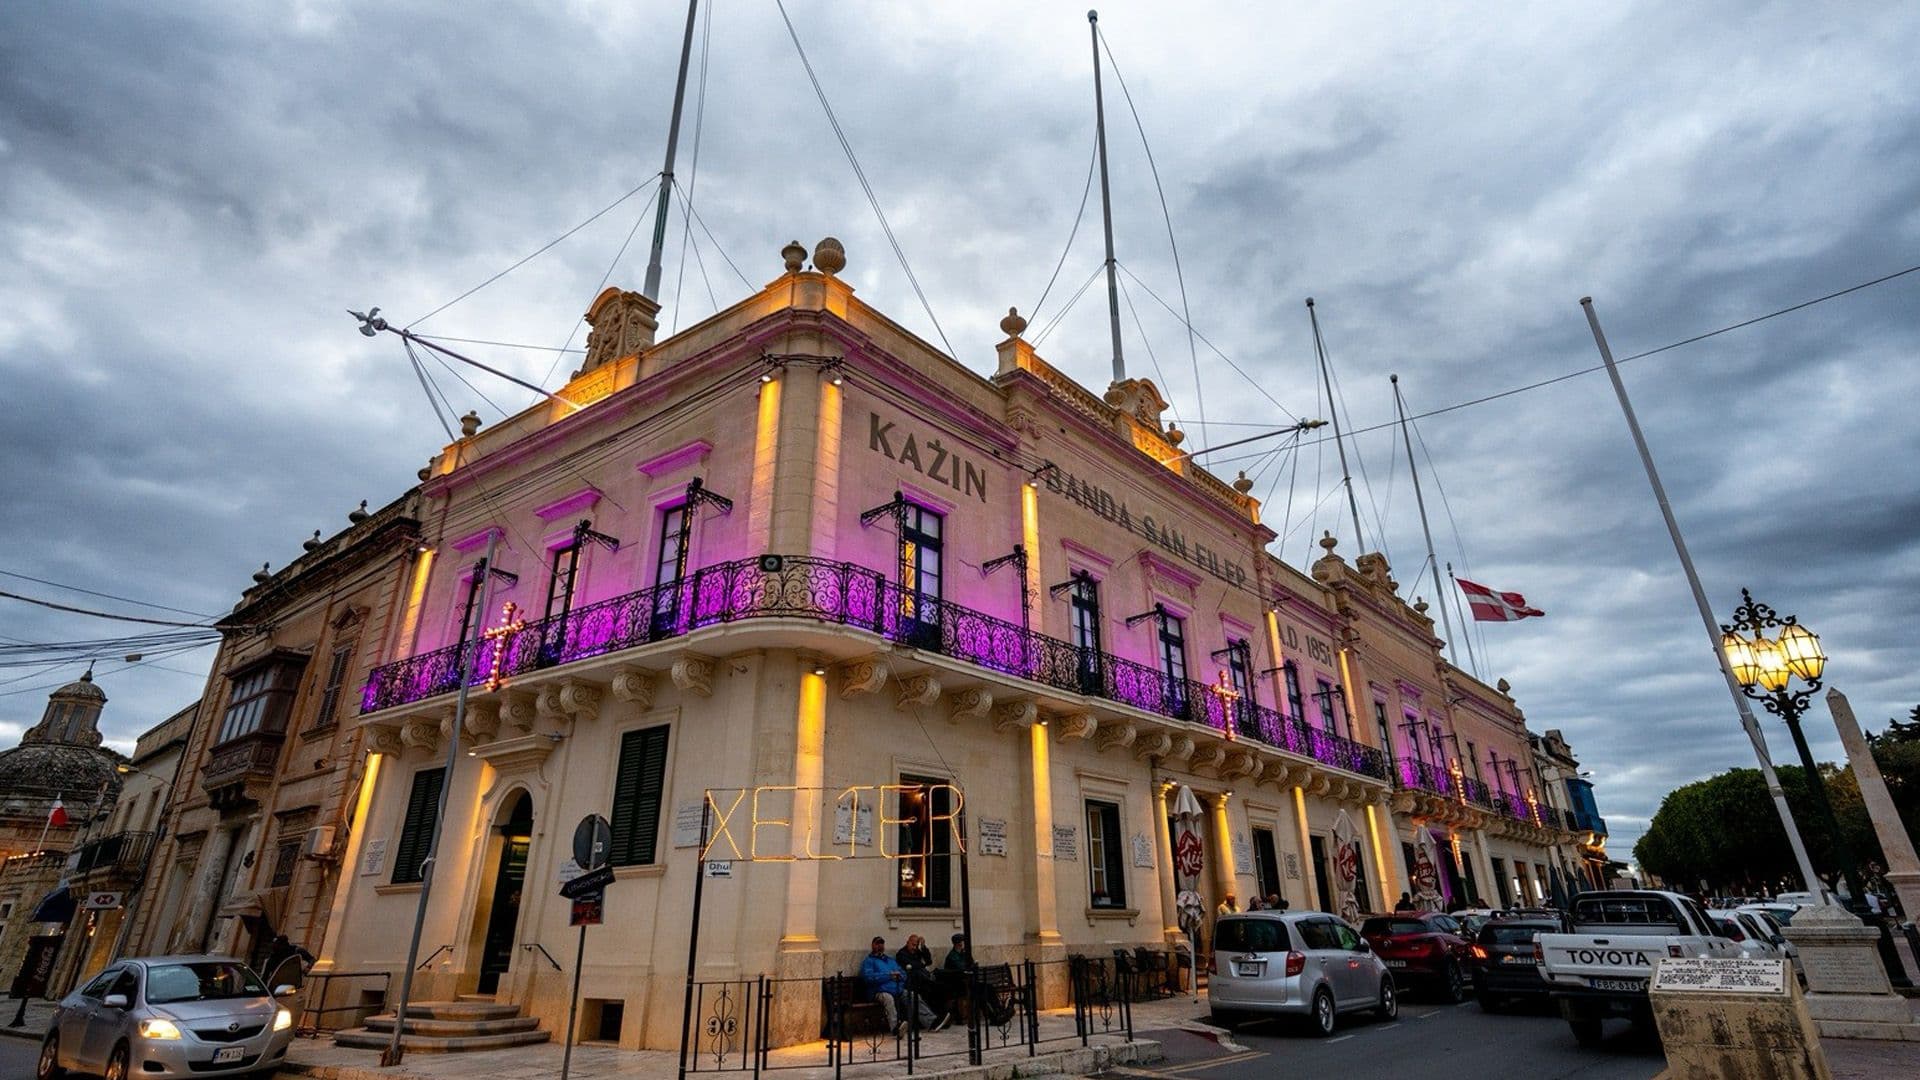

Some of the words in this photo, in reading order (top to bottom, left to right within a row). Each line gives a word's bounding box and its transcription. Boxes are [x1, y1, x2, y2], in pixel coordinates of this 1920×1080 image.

[869, 411, 987, 503] KAŻIN
[1046, 462, 1134, 533] BANDA
[1143, 514, 1188, 558] SAN
[1305, 634, 1333, 668] 1851
[1566, 949, 1652, 966] TOYOTA
